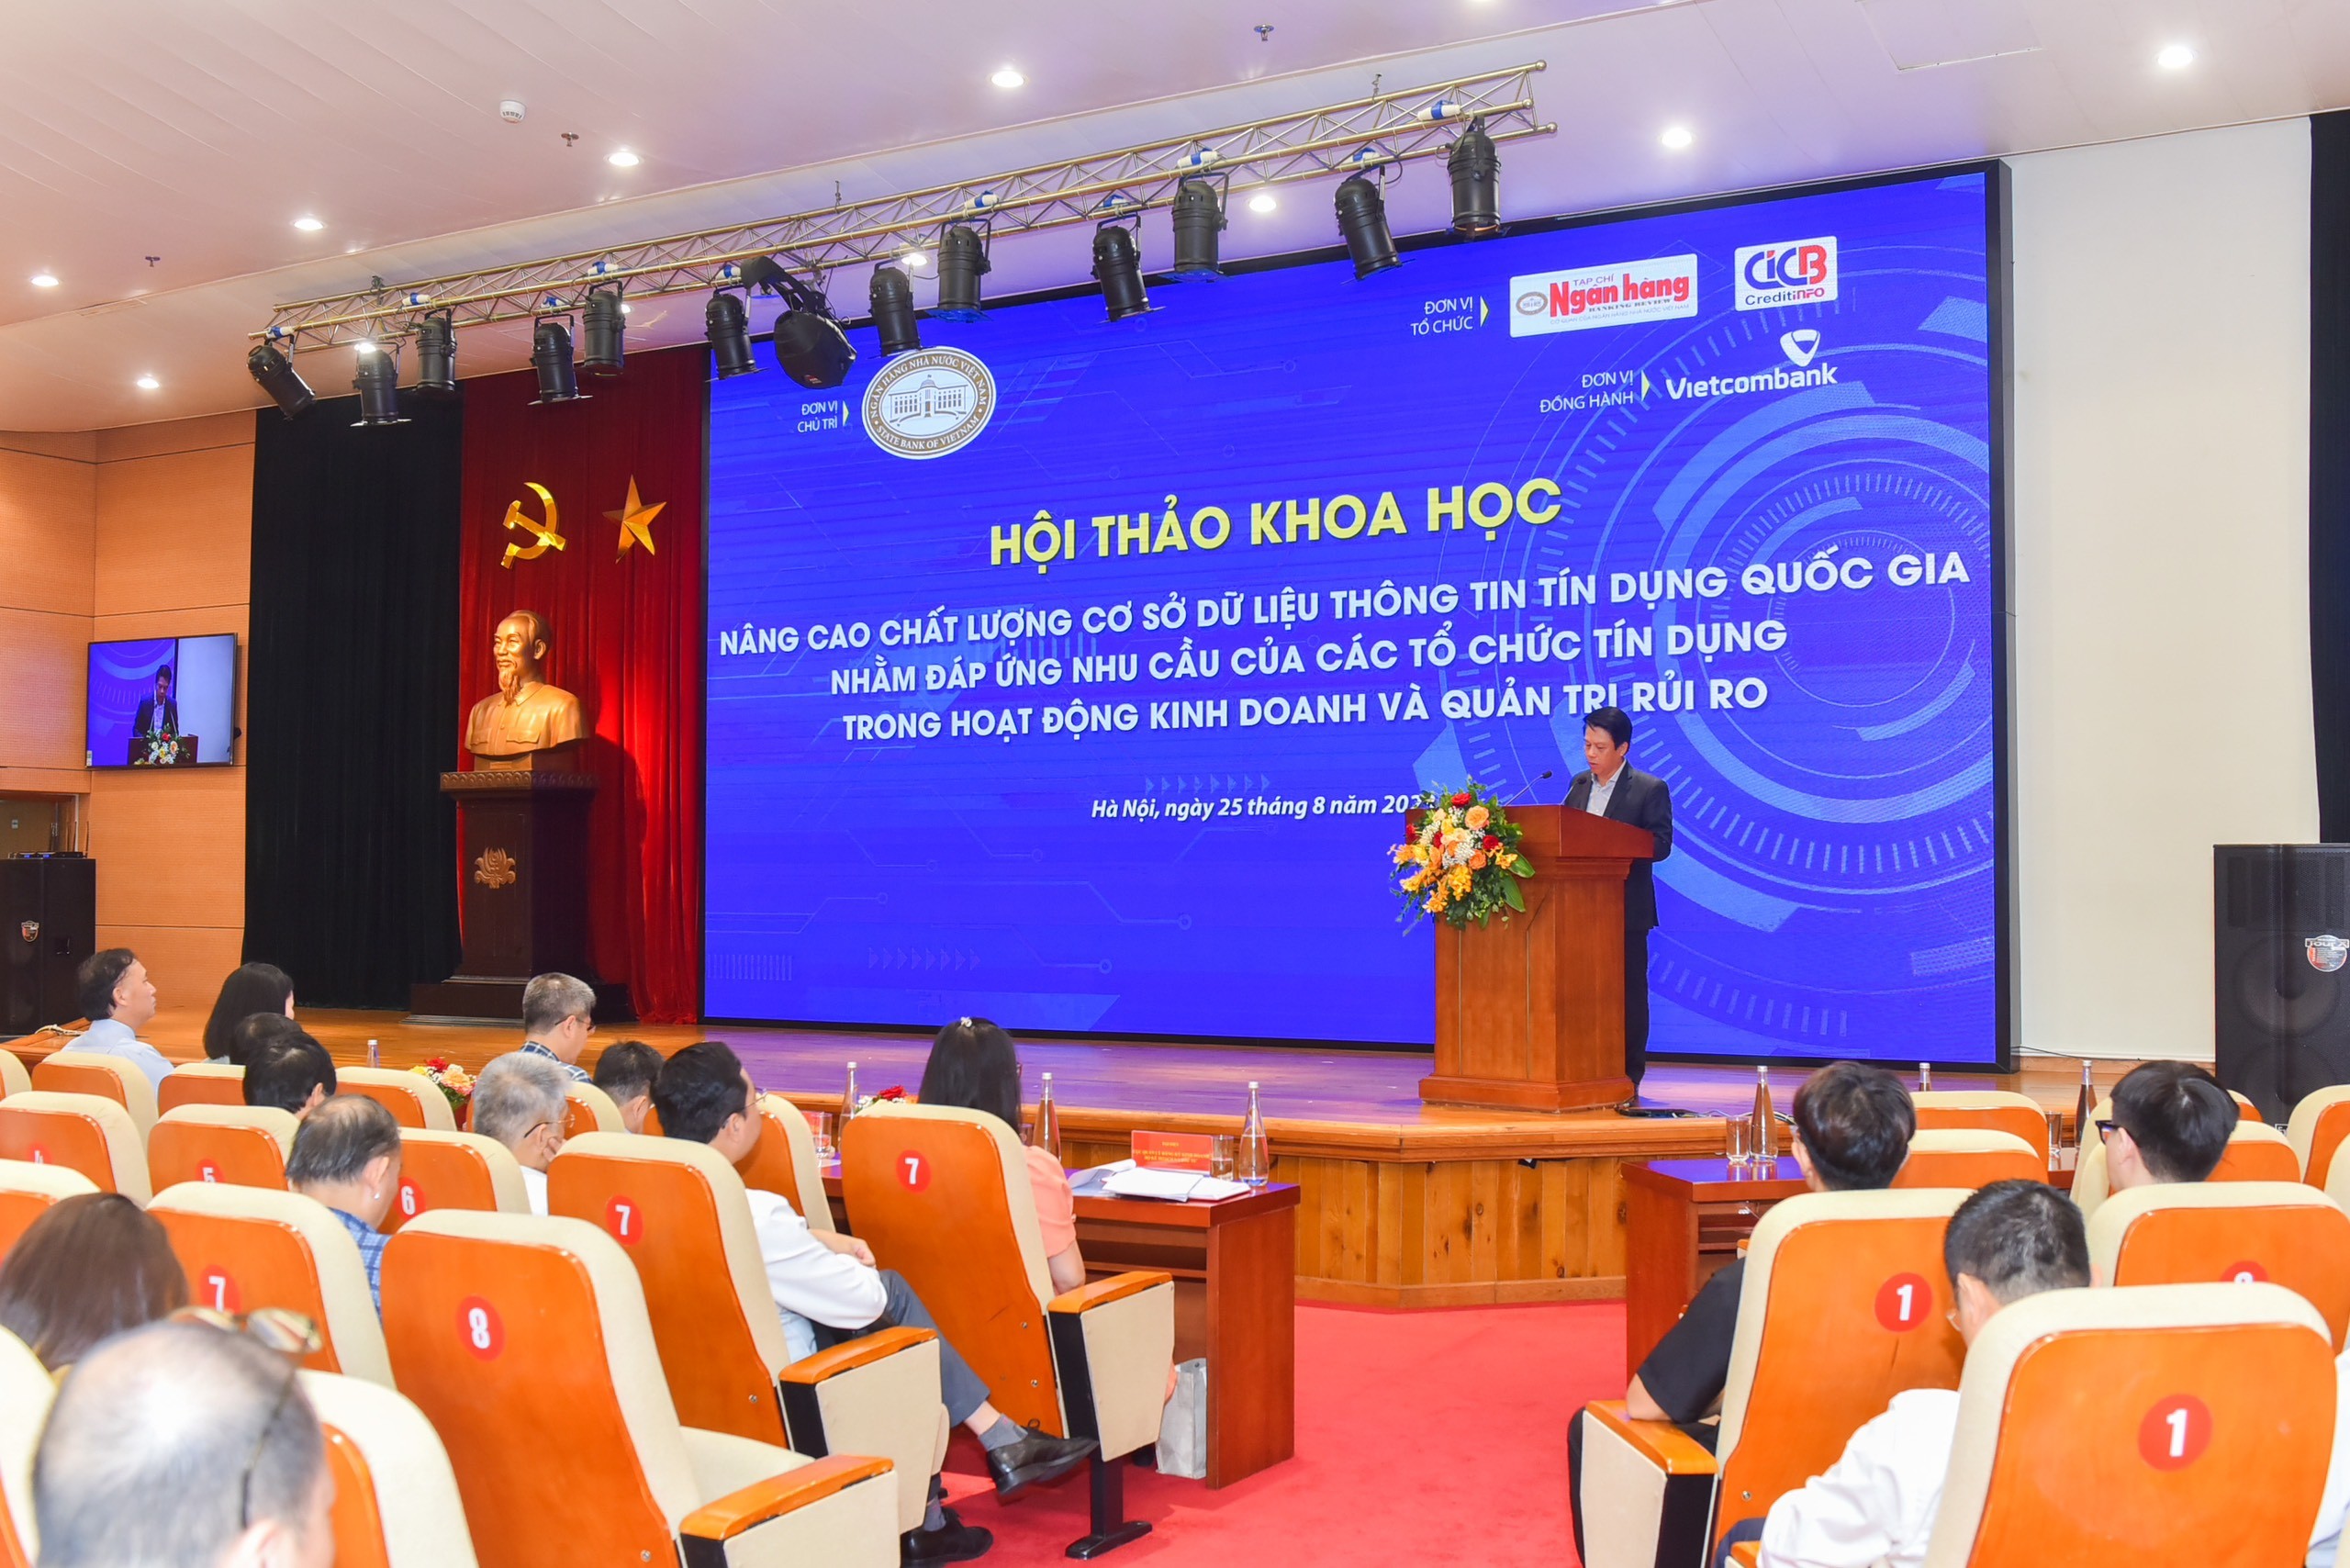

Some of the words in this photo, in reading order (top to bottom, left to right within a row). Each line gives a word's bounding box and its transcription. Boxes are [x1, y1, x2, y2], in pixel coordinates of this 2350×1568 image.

[1424, 298, 1457, 315] ĐƠN
[1460, 296, 1473, 312] VỊ
[1550, 281, 1618, 318] Ngân
[1622, 273, 1689, 302] hàng
[1410, 318, 1429, 336] TỔ
[1433, 316, 1473, 333] CHỨC
[870, 386, 884, 419] NGÂN
[881, 364, 908, 386] HÀNG
[909, 355, 930, 369] NHÀ
[931, 354, 959, 367] NƯỚC
[960, 361, 980, 380] VIỆT
[977, 378, 987, 405] NAM
[1582, 372, 1617, 388] ĐƠN
[1619, 369, 1633, 386] VỊ
[1665, 362, 1838, 400] Vietcombank
[801, 401, 826, 416] ĐƠN
[828, 400, 838, 414] VỊ
[1539, 395, 1585, 413] ĐỒNG
[1589, 390, 1634, 409] HÀNH
[797, 416, 821, 433] CHỦ
[822, 415, 838, 430] TRÌ
[877, 426, 900, 446] STATE
[900, 439, 925, 450] BANK
[926, 440, 939, 449] OF
[939, 416, 980, 445] VIETNAM
[990, 510, 1075, 574] HỘI
[1091, 494, 1231, 557] THẢO
[1250, 491, 1407, 545] KHOA
[1427, 477, 1562, 542] HỌC
[721, 622, 800, 655] NÂNG
[807, 622, 871, 651] CAO
[879, 604, 959, 645] CHẤT
[967, 607, 1073, 647] LƯỢNG
[1081, 600, 1133, 633] CƠ
[1142, 591, 1187, 631] SỞ
[1197, 591, 1245, 628] DỮ
[1254, 586, 1319, 631] LIỆU
[1329, 579, 1460, 620] THÔNG
[1470, 578, 1527, 611] TIN
[1538, 566, 1596, 608] TÍN
[1610, 566, 1729, 610] DỤNG
[1740, 544, 1874, 596] QUỐC
[1886, 551, 1971, 587] GIA
[831, 654, 916, 695] NHẰM
[924, 655, 987, 691] ĐÁP
[995, 653, 1063, 688] ỨNG
[1072, 653, 1138, 684] NHU
[1148, 635, 1220, 680] CẦU
[1230, 636, 1305, 677] CỦA
[1315, 633, 1398, 673] CÁC
[1408, 621, 1457, 667] TỔ
[1469, 622, 1582, 665] CHỨC
[1593, 618, 1652, 658] TÍN
[1666, 619, 1788, 663] DỤNG
[842, 711, 942, 741] TRONG
[951, 708, 1034, 743] HOẠT
[1041, 698, 1139, 741] ĐỘNG
[1149, 700, 1228, 730] KINH
[1239, 693, 1367, 728] DOANH
[1378, 682, 1430, 722] VÀ
[1440, 677, 1551, 720] QUẢN
[1632, 669, 1695, 712] RỦI
[1709, 677, 1768, 711] RO
[1091, 799, 1118, 818] Hà
[1122, 798, 1160, 823] Nội,
[1165, 797, 1215, 822] ngày
[1217, 798, 1243, 817] 25
[1248, 795, 1308, 821] tháng
[1313, 796, 1326, 815] 8
[1329, 795, 1378, 814] năm
[1381, 794, 1435, 814] 202
[903, 1157, 920, 1185] 7
[401, 1186, 416, 1215] 6
[616, 1204, 631, 1236] 7
[208, 1275, 226, 1313] 7
[1897, 1284, 1913, 1321] 1
[468, 1307, 491, 1350] 8
[2166, 1408, 2188, 1457] 1
